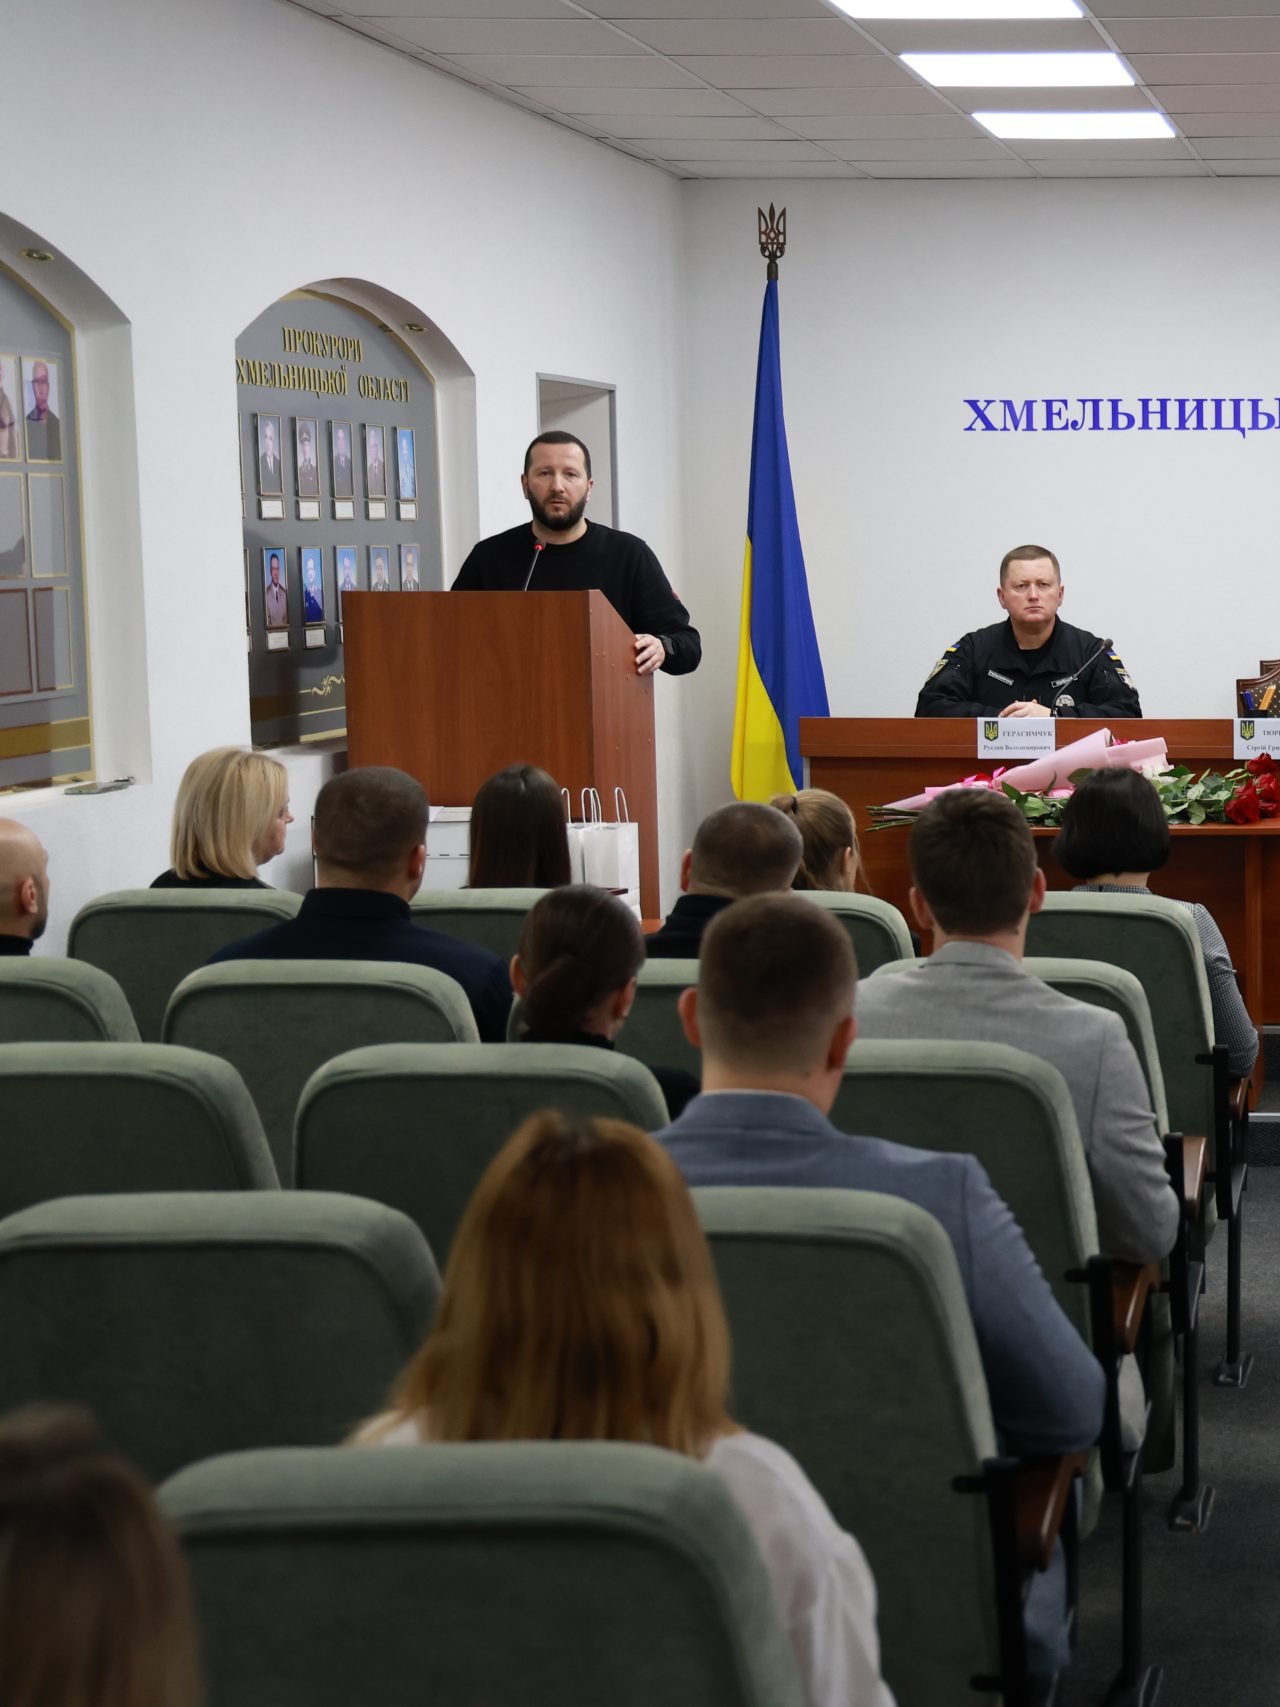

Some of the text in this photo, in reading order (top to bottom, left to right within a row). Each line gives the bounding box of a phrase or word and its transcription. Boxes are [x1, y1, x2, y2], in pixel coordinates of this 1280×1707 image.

[282, 327, 363, 362] ПРОКУРОРИ
[235, 358, 409, 402] ХМЕЛЬНИЦЬКОЇ ОБЛАСТІ
